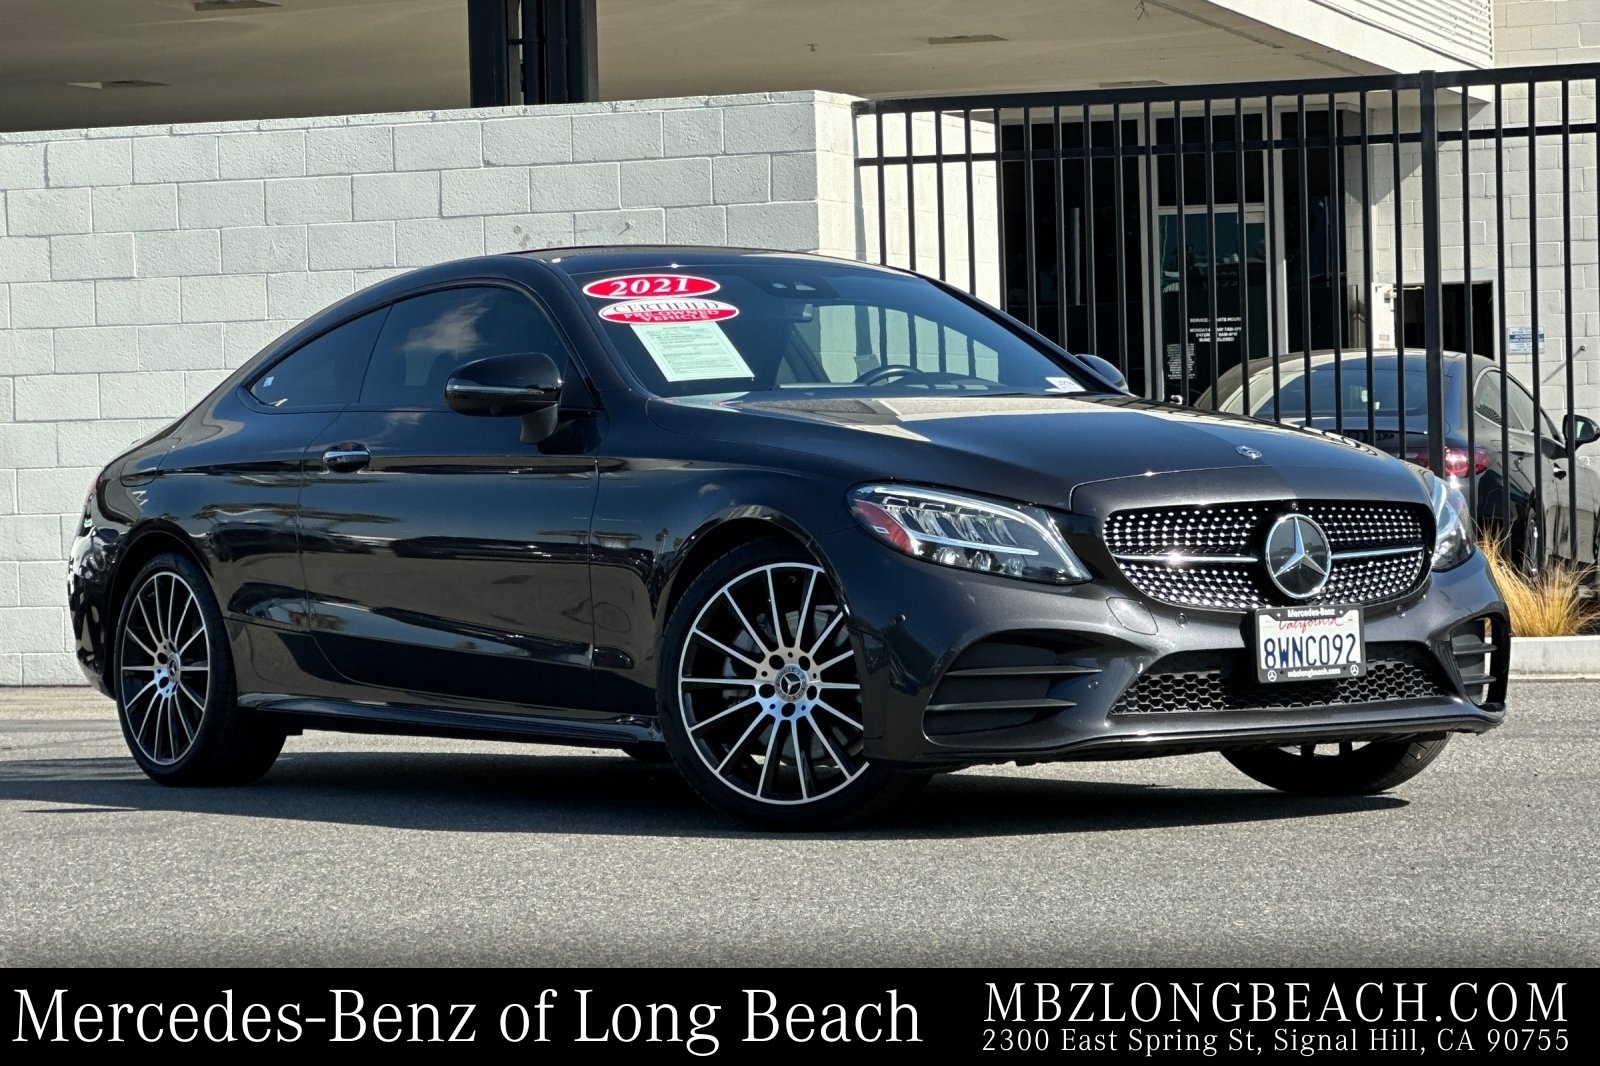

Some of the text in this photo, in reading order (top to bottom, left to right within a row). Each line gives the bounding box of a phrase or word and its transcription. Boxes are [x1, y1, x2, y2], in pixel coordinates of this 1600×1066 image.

[609, 278, 689, 296] 2021
[613, 301, 719, 312] CERTIFIED
[624, 309, 720, 319] PRE-OWNED
[643, 314, 711, 322] VEHICLE
[1287, 608, 1335, 618] Mercedes-Benz
[1264, 633, 1357, 669] 8WNC092
